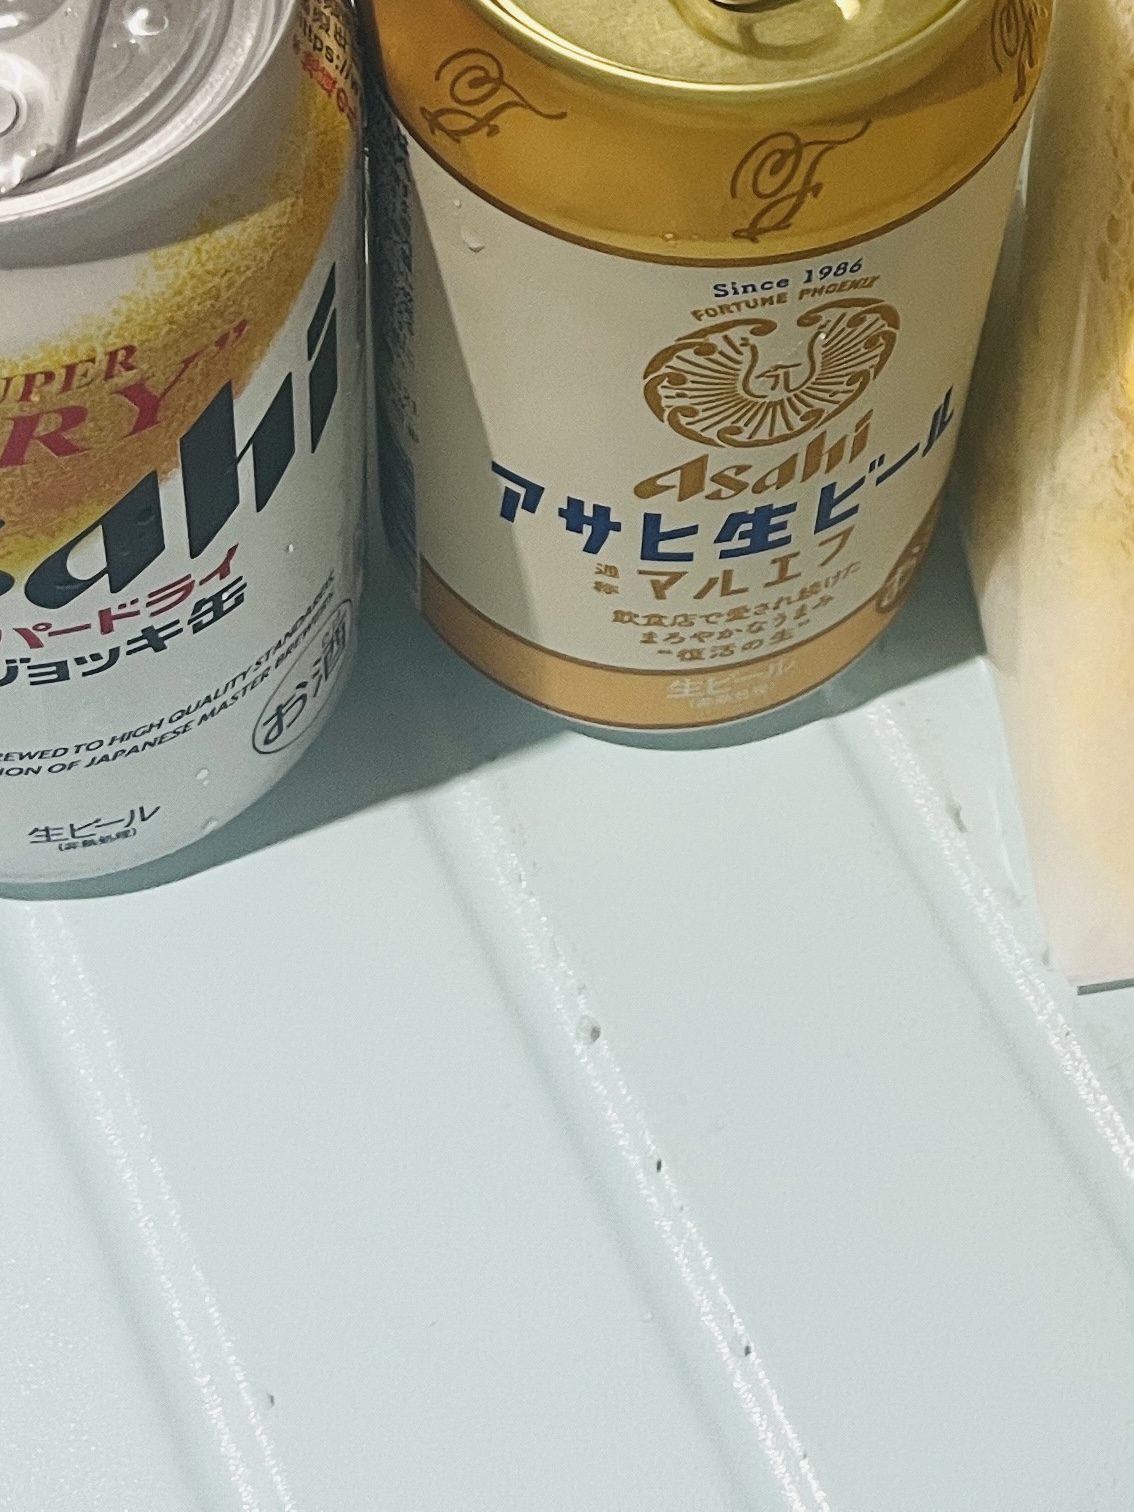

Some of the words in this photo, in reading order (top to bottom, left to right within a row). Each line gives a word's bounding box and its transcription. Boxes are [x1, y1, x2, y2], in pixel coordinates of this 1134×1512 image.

[690, 292, 788, 321] FORTUNE
[713, 277, 790, 298] Since
[803, 258, 863, 284] 1986
[0, 262, 338, 609] ahi
[490, 384, 954, 562] アサヒ生ビール
[633, 408, 873, 502] Asahi
[637, 530, 851, 600] マルエフ
[48, 760, 81, 773] OF
[84, 720, 193, 768] JAPANESE
[197, 666, 271, 726] MASTER
[74, 740, 104, 754] TO
[108, 717, 165, 746] HIGH
[168, 664, 252, 724] QUALITY
[28, 806, 160, 844] 生ビール
